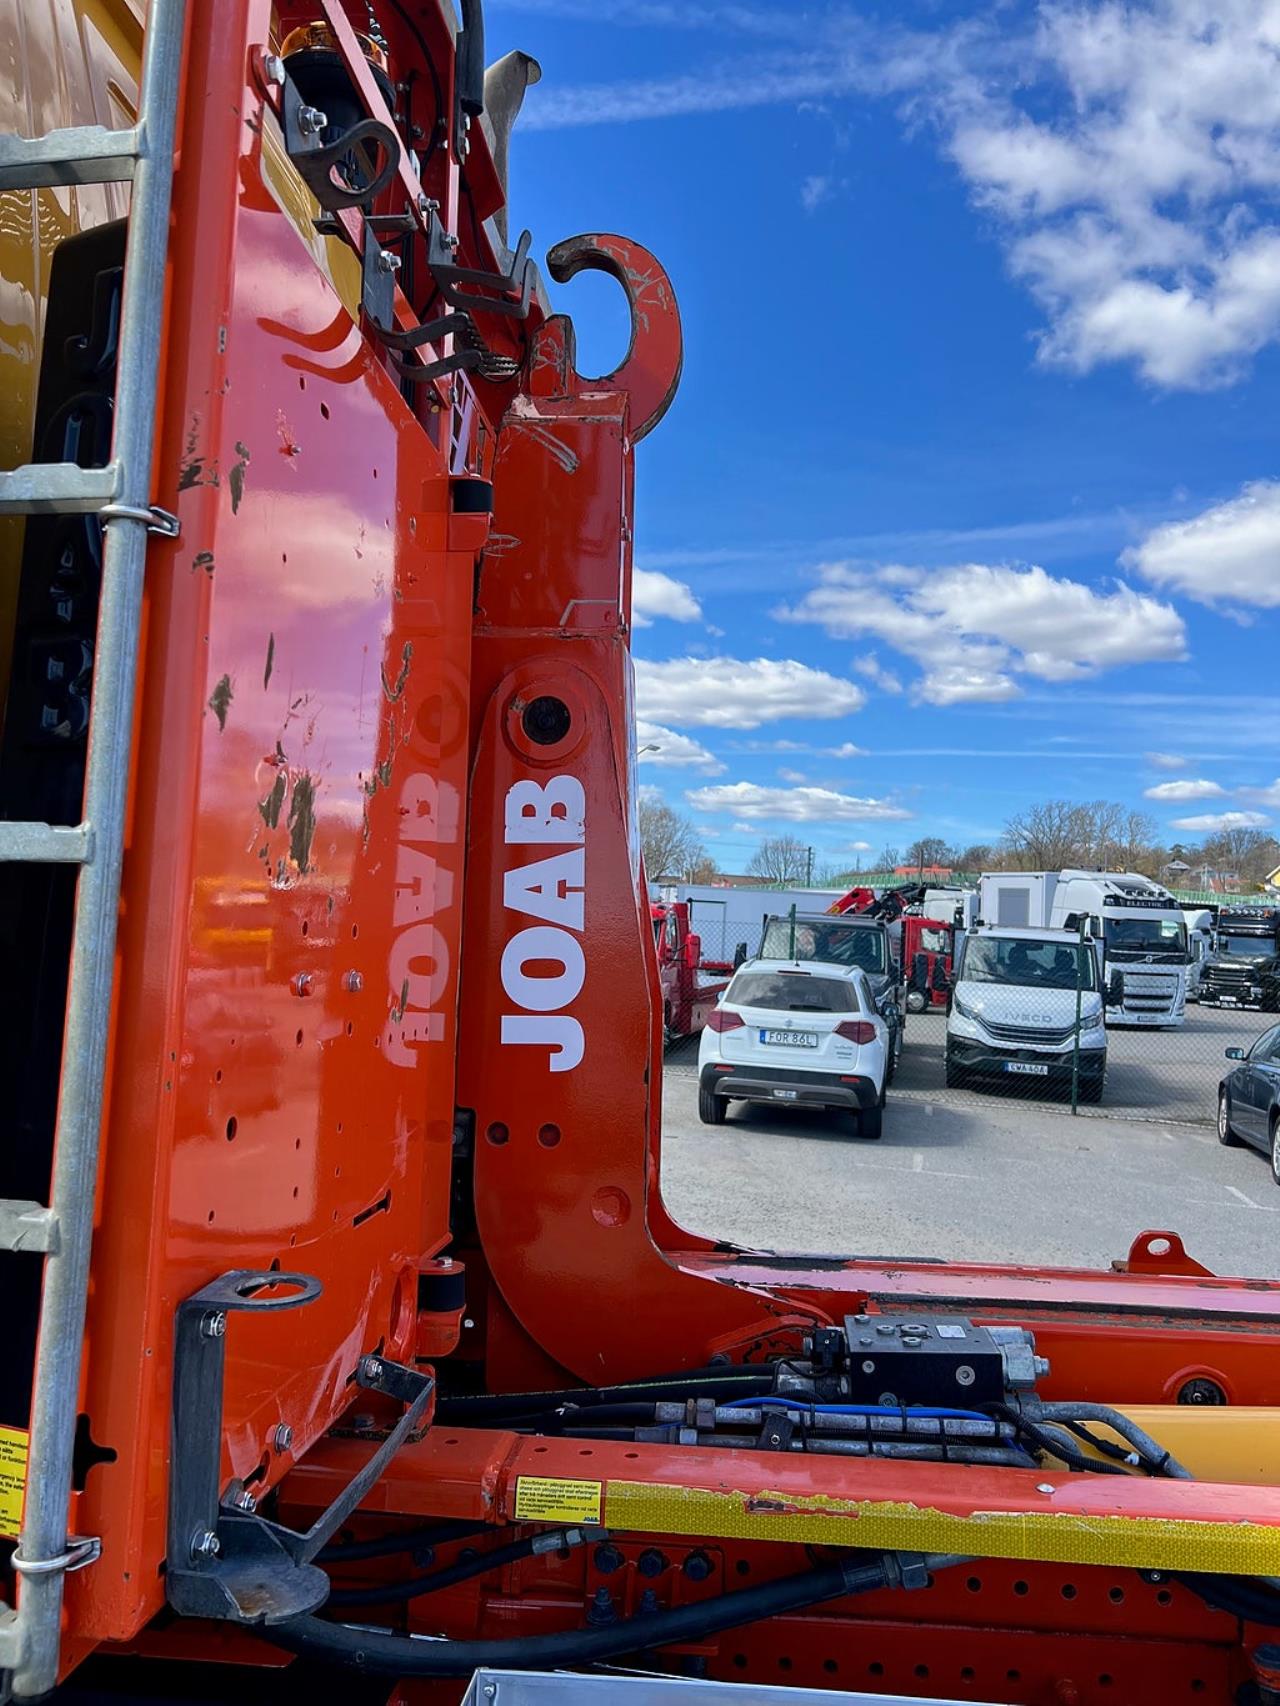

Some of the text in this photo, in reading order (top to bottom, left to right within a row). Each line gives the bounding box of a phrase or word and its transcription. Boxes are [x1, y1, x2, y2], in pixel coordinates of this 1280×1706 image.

[500, 774, 586, 1072] JOAB
[1003, 1013, 1053, 1023] IVECO
[768, 1031, 812, 1044] FOR 86L
